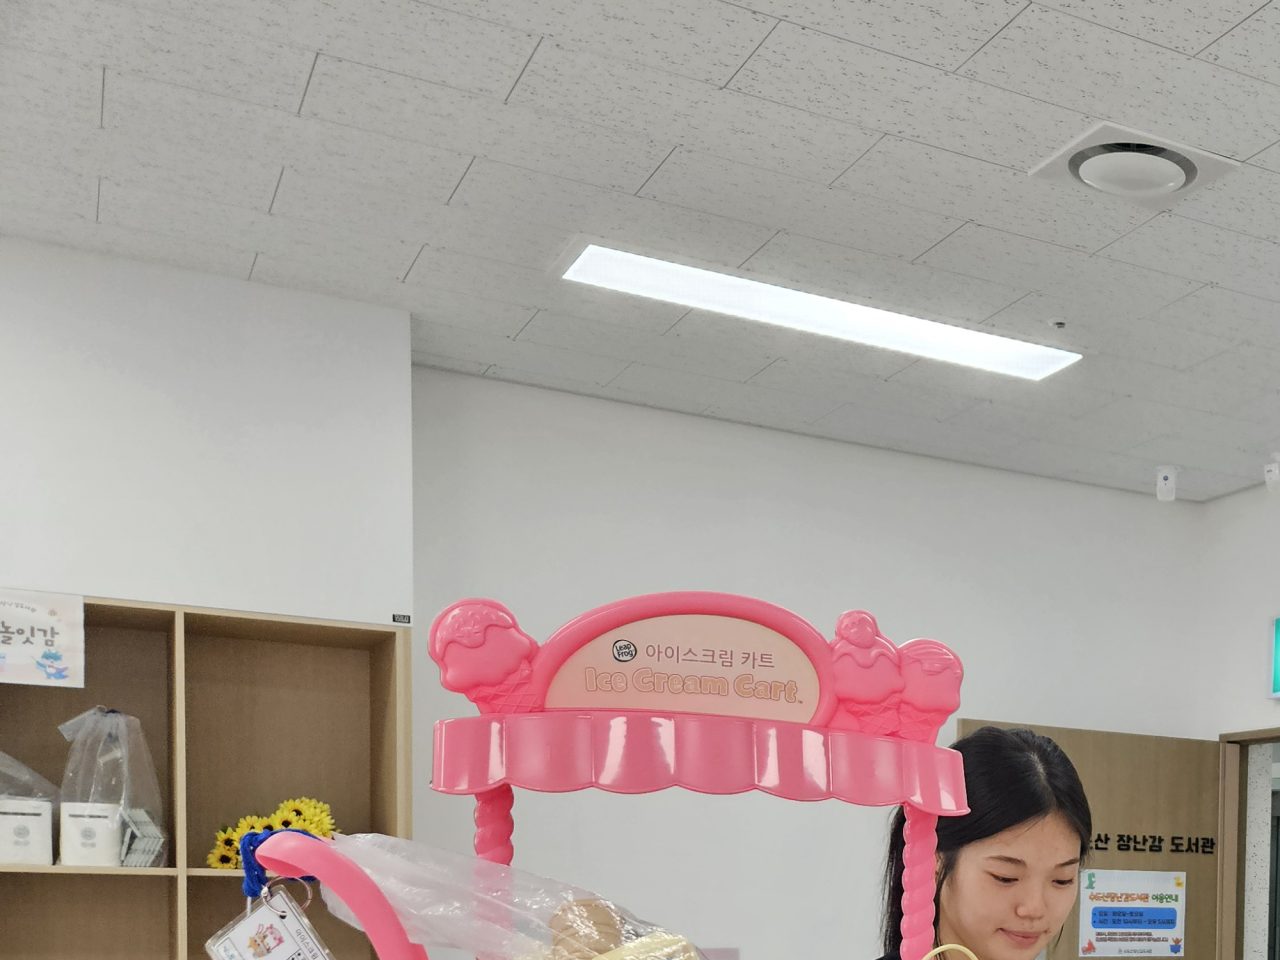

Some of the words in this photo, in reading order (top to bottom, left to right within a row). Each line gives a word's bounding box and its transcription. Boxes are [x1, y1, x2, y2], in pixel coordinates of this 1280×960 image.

[645, 644, 734, 667] 아이스크림
[741, 651, 775, 669] 카트
[584, 667, 627, 692] Ice
[632, 667, 729, 696] Cream
[734, 674, 798, 703] Cart
[1117, 834, 1164, 852] 장난감
[1170, 836, 1216, 854] 도서관
